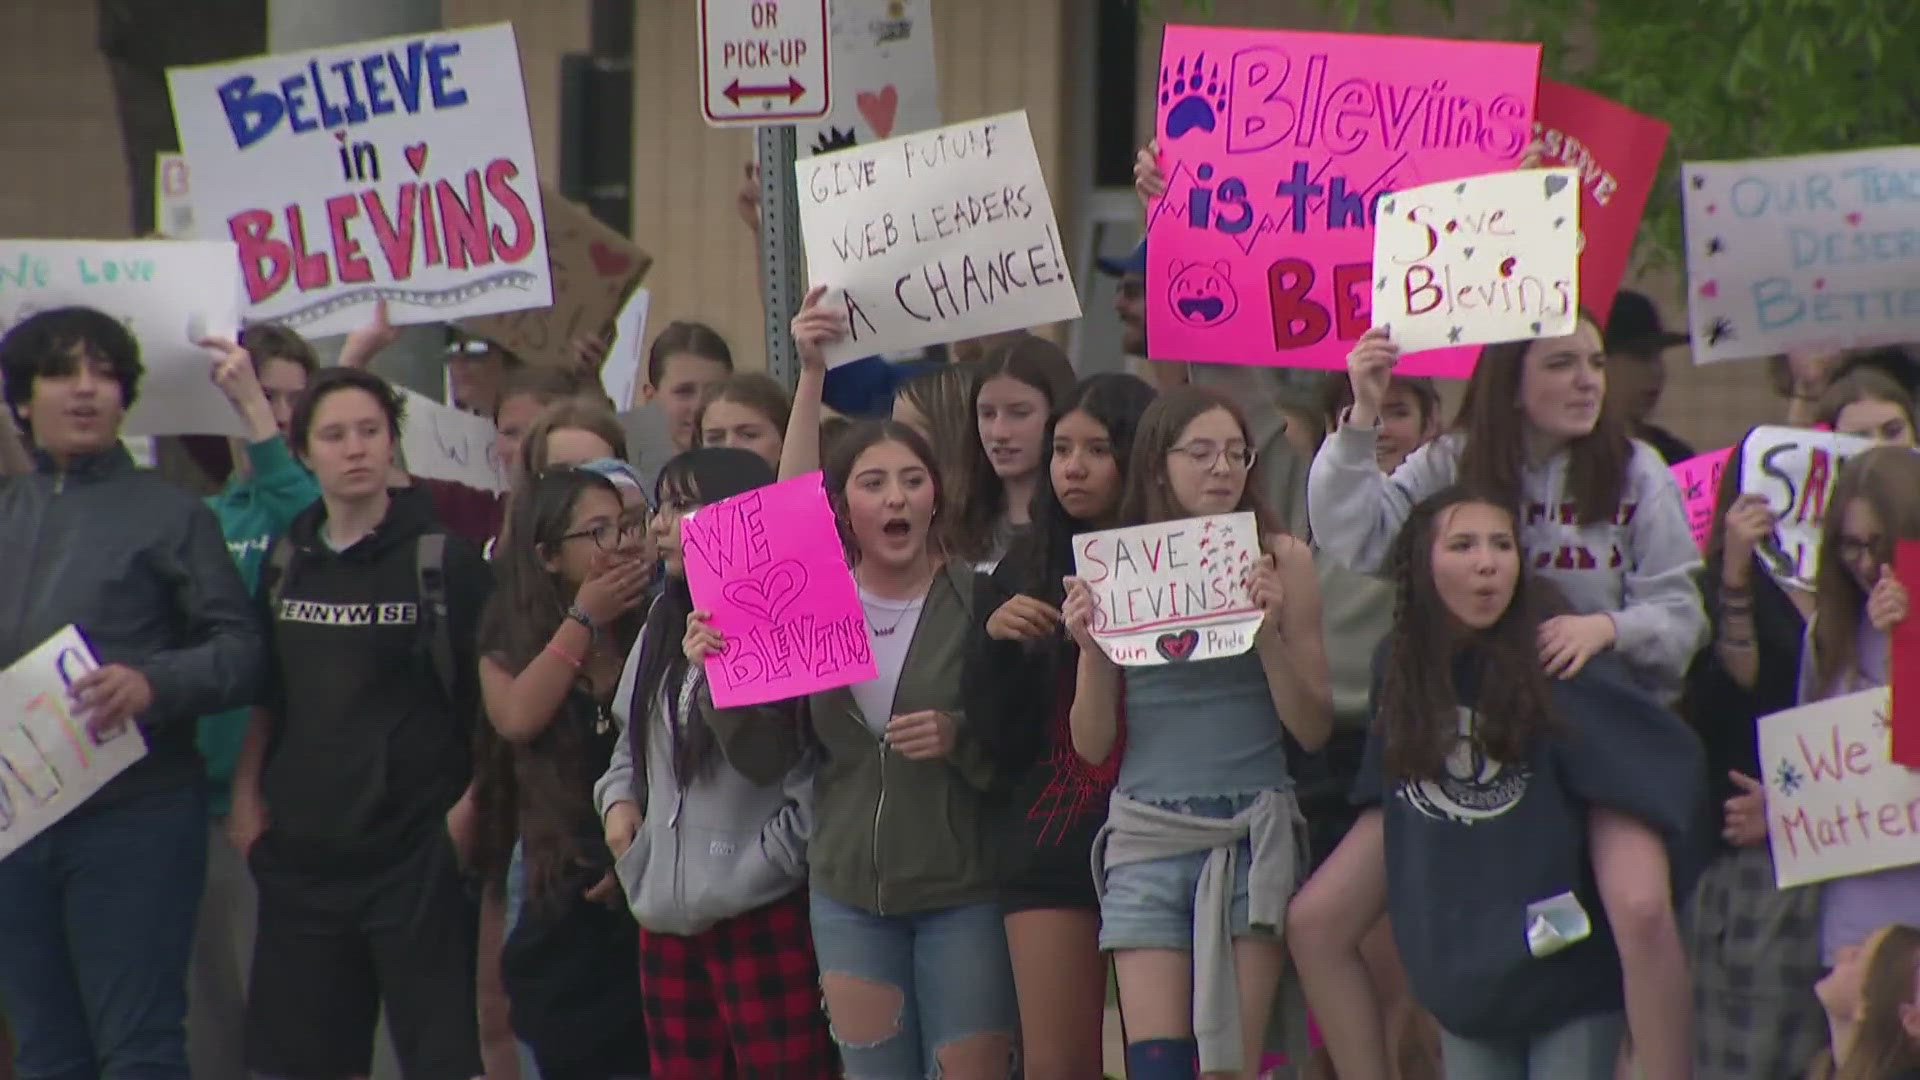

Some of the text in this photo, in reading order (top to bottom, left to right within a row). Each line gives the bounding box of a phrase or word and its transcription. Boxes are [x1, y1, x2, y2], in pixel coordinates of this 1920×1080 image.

[751, 3, 778, 29] OR
[723, 39, 808, 68] PICK-UP
[217, 41, 468, 150] BELIEVE
[1226, 46, 1527, 161] Blevins
[334, 130, 380, 182] in
[810, 159, 877, 204] GIVE
[1534, 121, 1618, 206] SERVE
[911, 184, 1033, 244] LEADERS
[1187, 160, 1391, 235] is th
[227, 158, 536, 305] BLEVINS
[832, 212, 899, 262] WEB
[842, 222, 1066, 343] A CHANCE!
[1404, 256, 1570, 317] Blevins
[682, 491, 772, 579] WE
[1084, 531, 1188, 583] SAVE
[282, 600, 417, 625] ENNYWISE
[1093, 576, 1229, 635] BLEVINS
[714, 612, 872, 691] BLEVINS
[1110, 630, 1246, 661] uin Pride
[1797, 722, 1873, 782] We
[1780, 797, 1920, 861] Matter
